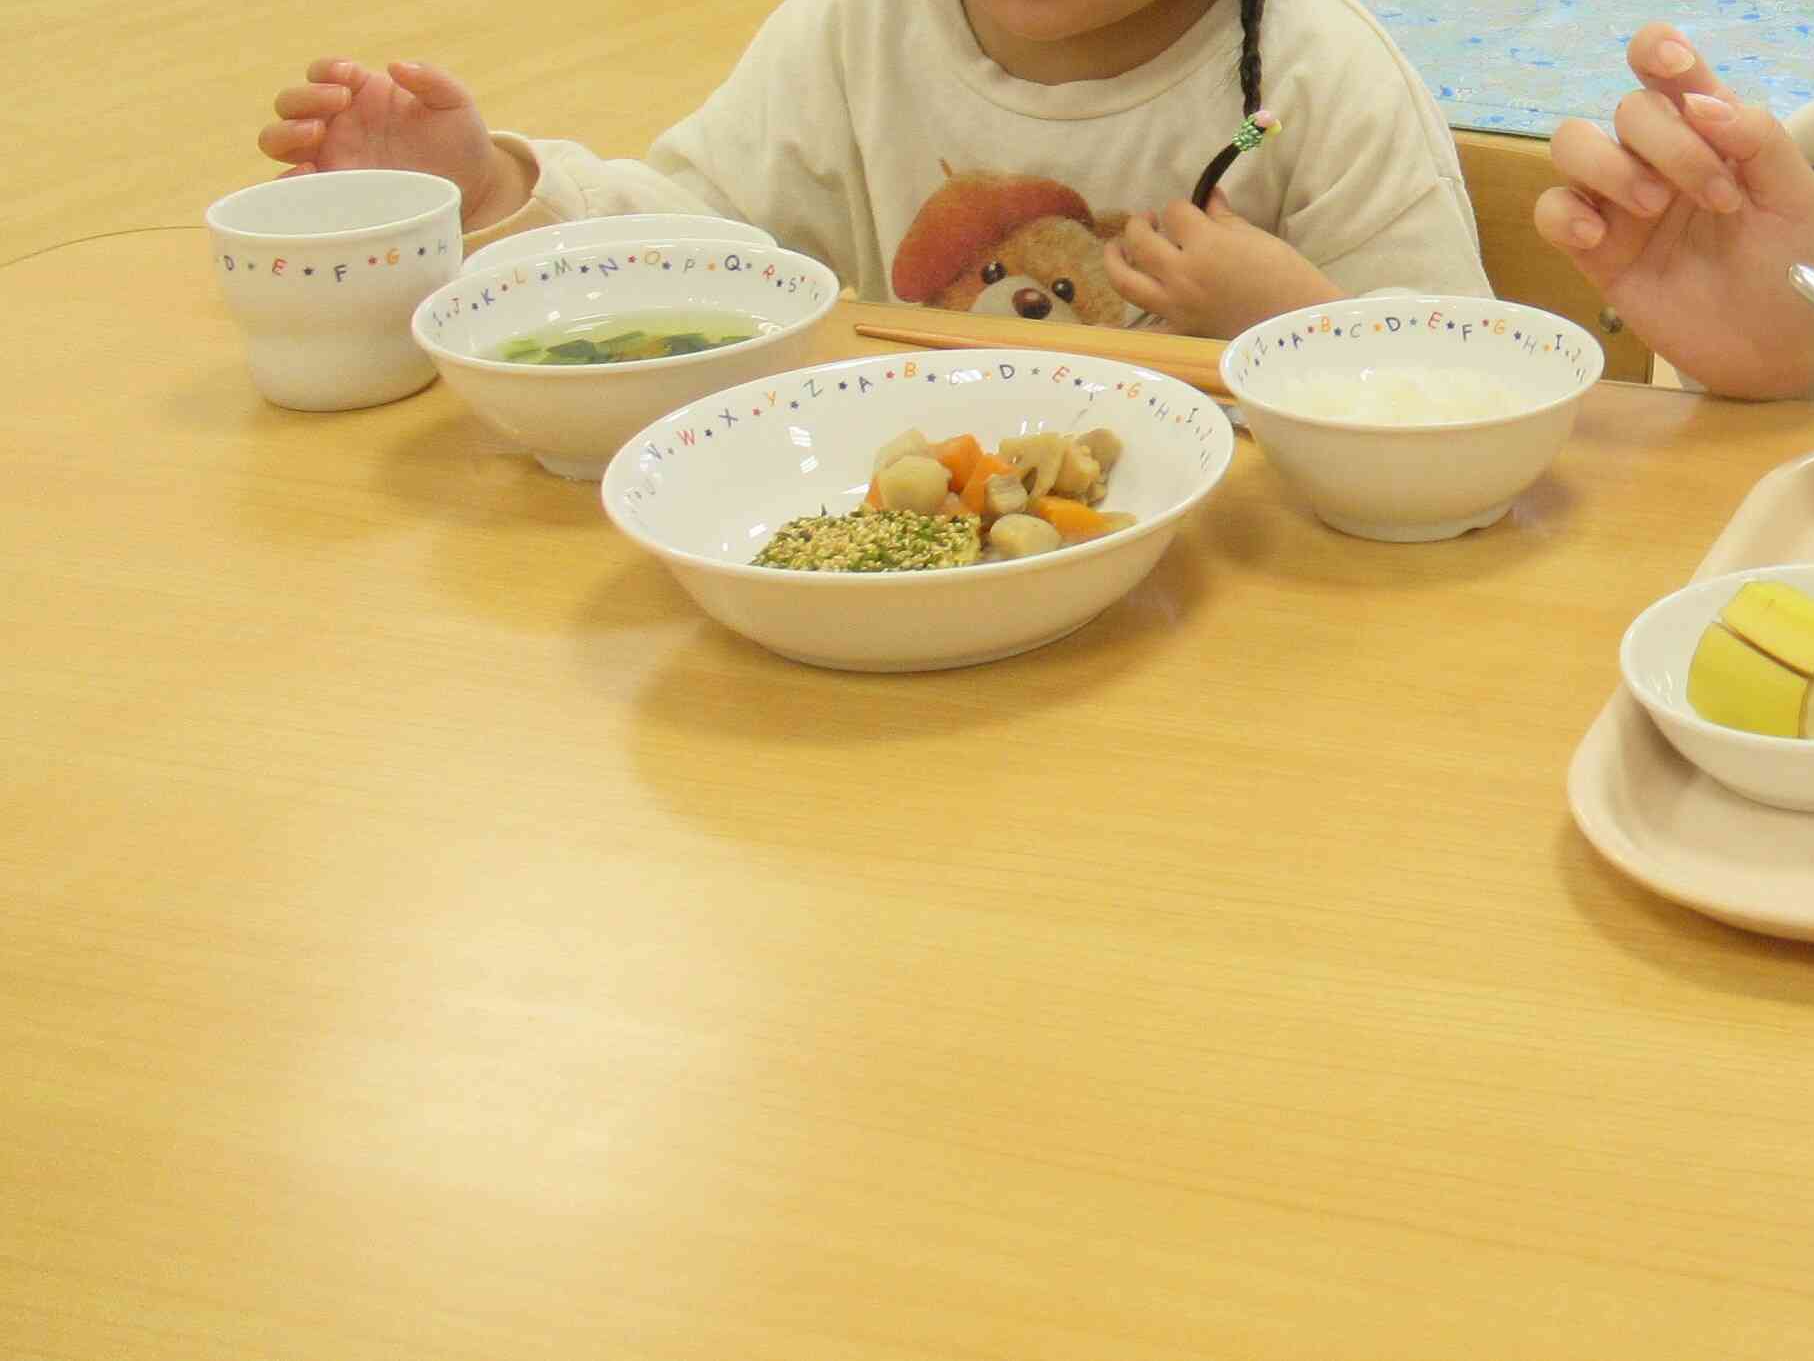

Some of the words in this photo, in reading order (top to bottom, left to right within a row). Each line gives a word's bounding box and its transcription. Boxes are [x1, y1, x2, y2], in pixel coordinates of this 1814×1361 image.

[224, 255, 235, 271] D
[272, 258, 288, 276] E
[334, 264, 347, 282] F
[386, 248, 399, 265] G
[481, 289, 495, 306] K
[513, 270, 526, 285] L
[554, 257, 572, 275] M
[599, 257, 619, 277] N
[645, 251, 660, 265] O
[684, 258, 696, 274] P
[724, 255, 742, 271] Q
[761, 264, 776, 279] R
[788, 278, 797, 293] S
[1292, 332, 1303, 349] A
[1321, 315, 1331, 333] B
[1350, 323, 1362, 339] C
[1386, 317, 1401, 332] D
[1428, 311, 1443, 329] E
[1462, 323, 1472, 341] F
[1494, 319, 1505, 335] G
[1522, 335, 1536, 355] H
[1554, 334, 1563, 351] I
[677, 429, 696, 446] W
[718, 407, 738, 428] X
[764, 391, 777, 407] Y
[803, 379, 824, 399] Z
[858, 376, 873, 393] A
[904, 361, 918, 379] B
[1000, 364, 1015, 380] D
[1052, 366, 1070, 383] E
[1154, 402, 1170, 421] H
[1186, 407, 1198, 423] I
